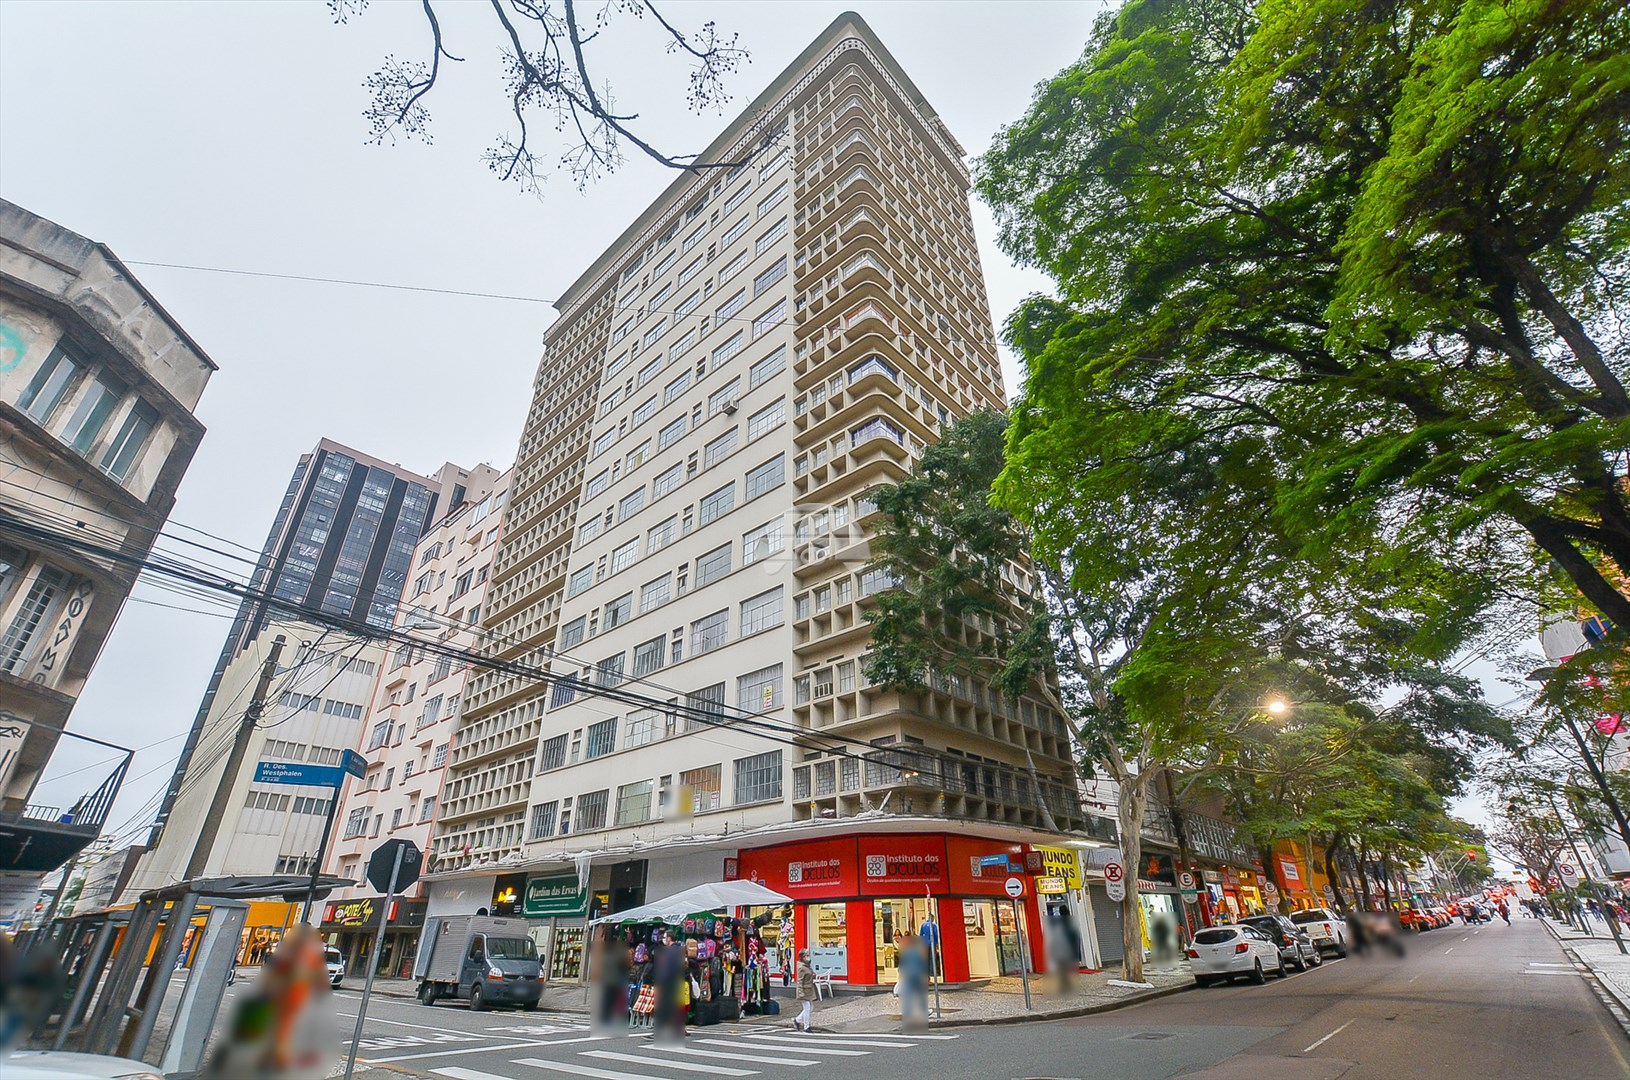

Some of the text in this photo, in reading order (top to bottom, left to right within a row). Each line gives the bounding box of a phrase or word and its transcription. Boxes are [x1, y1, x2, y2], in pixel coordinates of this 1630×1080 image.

[262, 769, 302, 777] Westphalen
[886, 853, 940, 863] Instituto dos
[802, 858, 840, 869] Instituto dos
[533, 885, 577, 898] Jardim das Ervas
